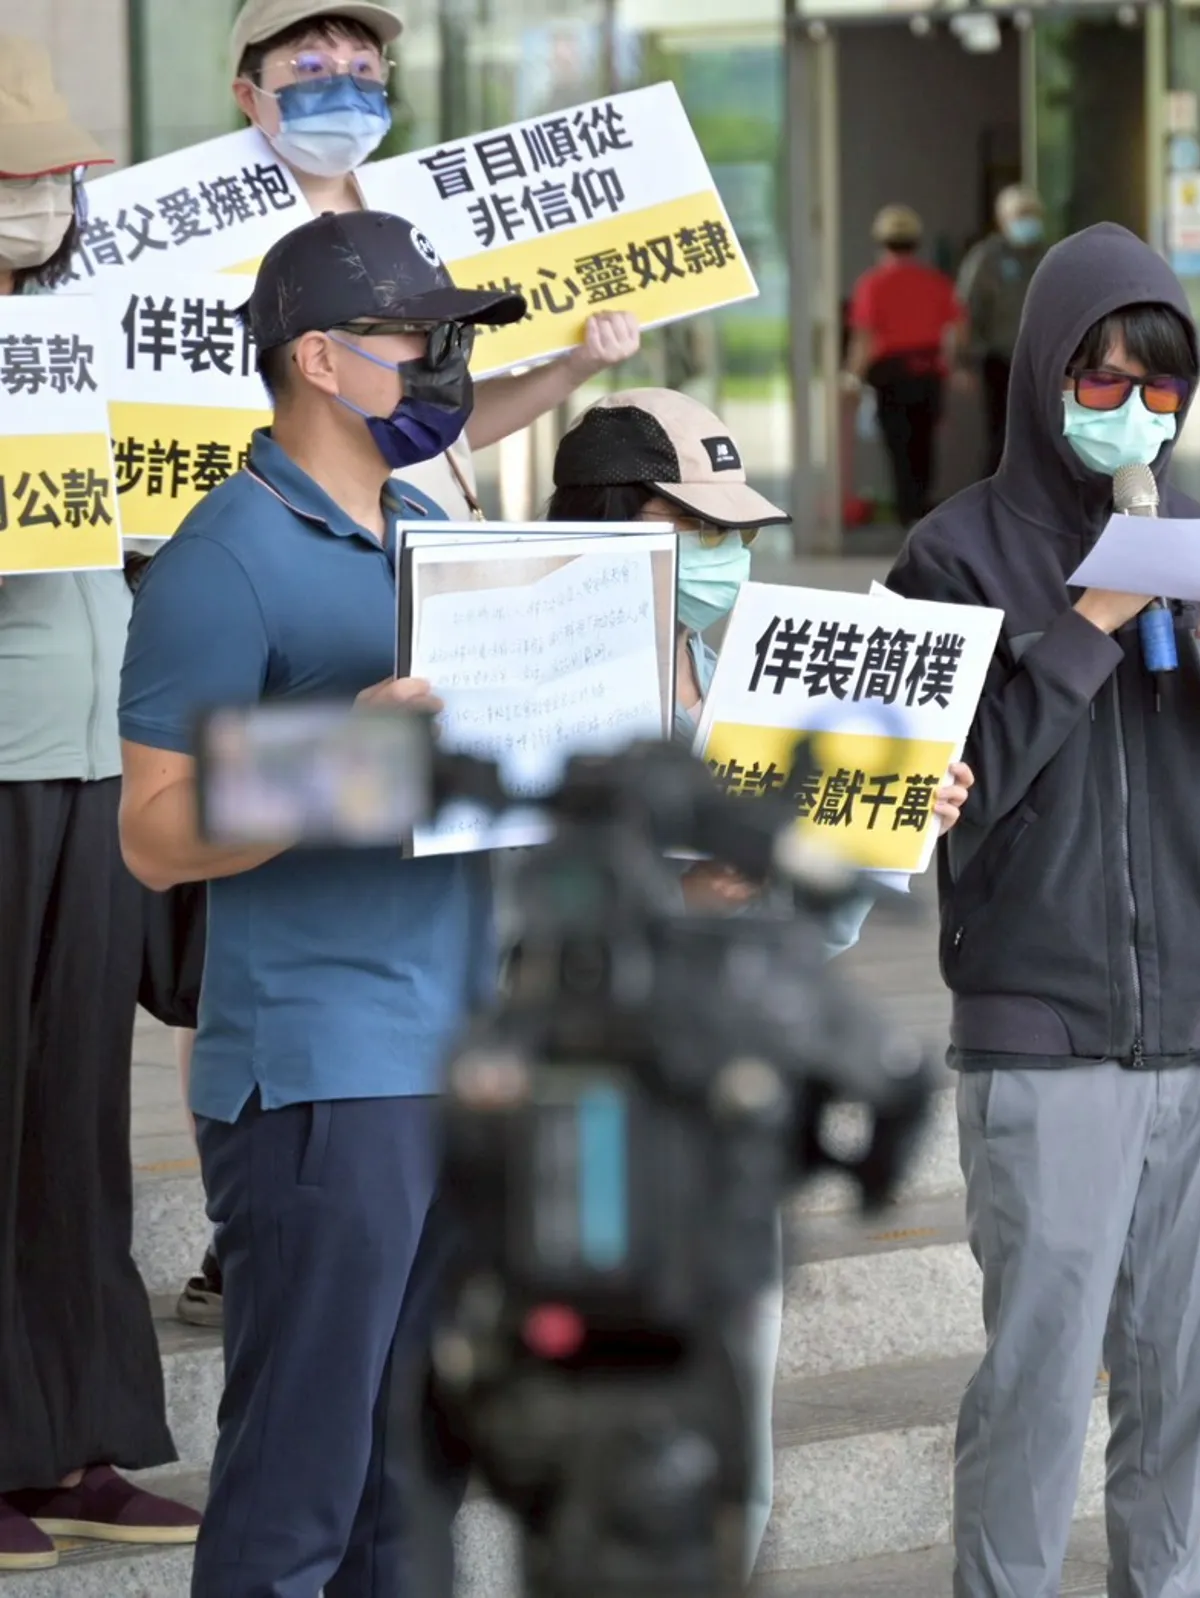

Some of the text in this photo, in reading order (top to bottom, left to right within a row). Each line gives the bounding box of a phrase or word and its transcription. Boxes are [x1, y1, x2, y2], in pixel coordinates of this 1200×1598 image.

[418, 102, 634, 200] 盲目順從
[57, 163, 297, 287] 借父愛擁抱
[467, 167, 626, 248] 非信仰
[121, 293, 261, 377] 佯裝
[0, 467, 114, 532] 公款
[110, 436, 254, 499] 涉詐奉
[748, 615, 966, 709] 佯裝簡樸
